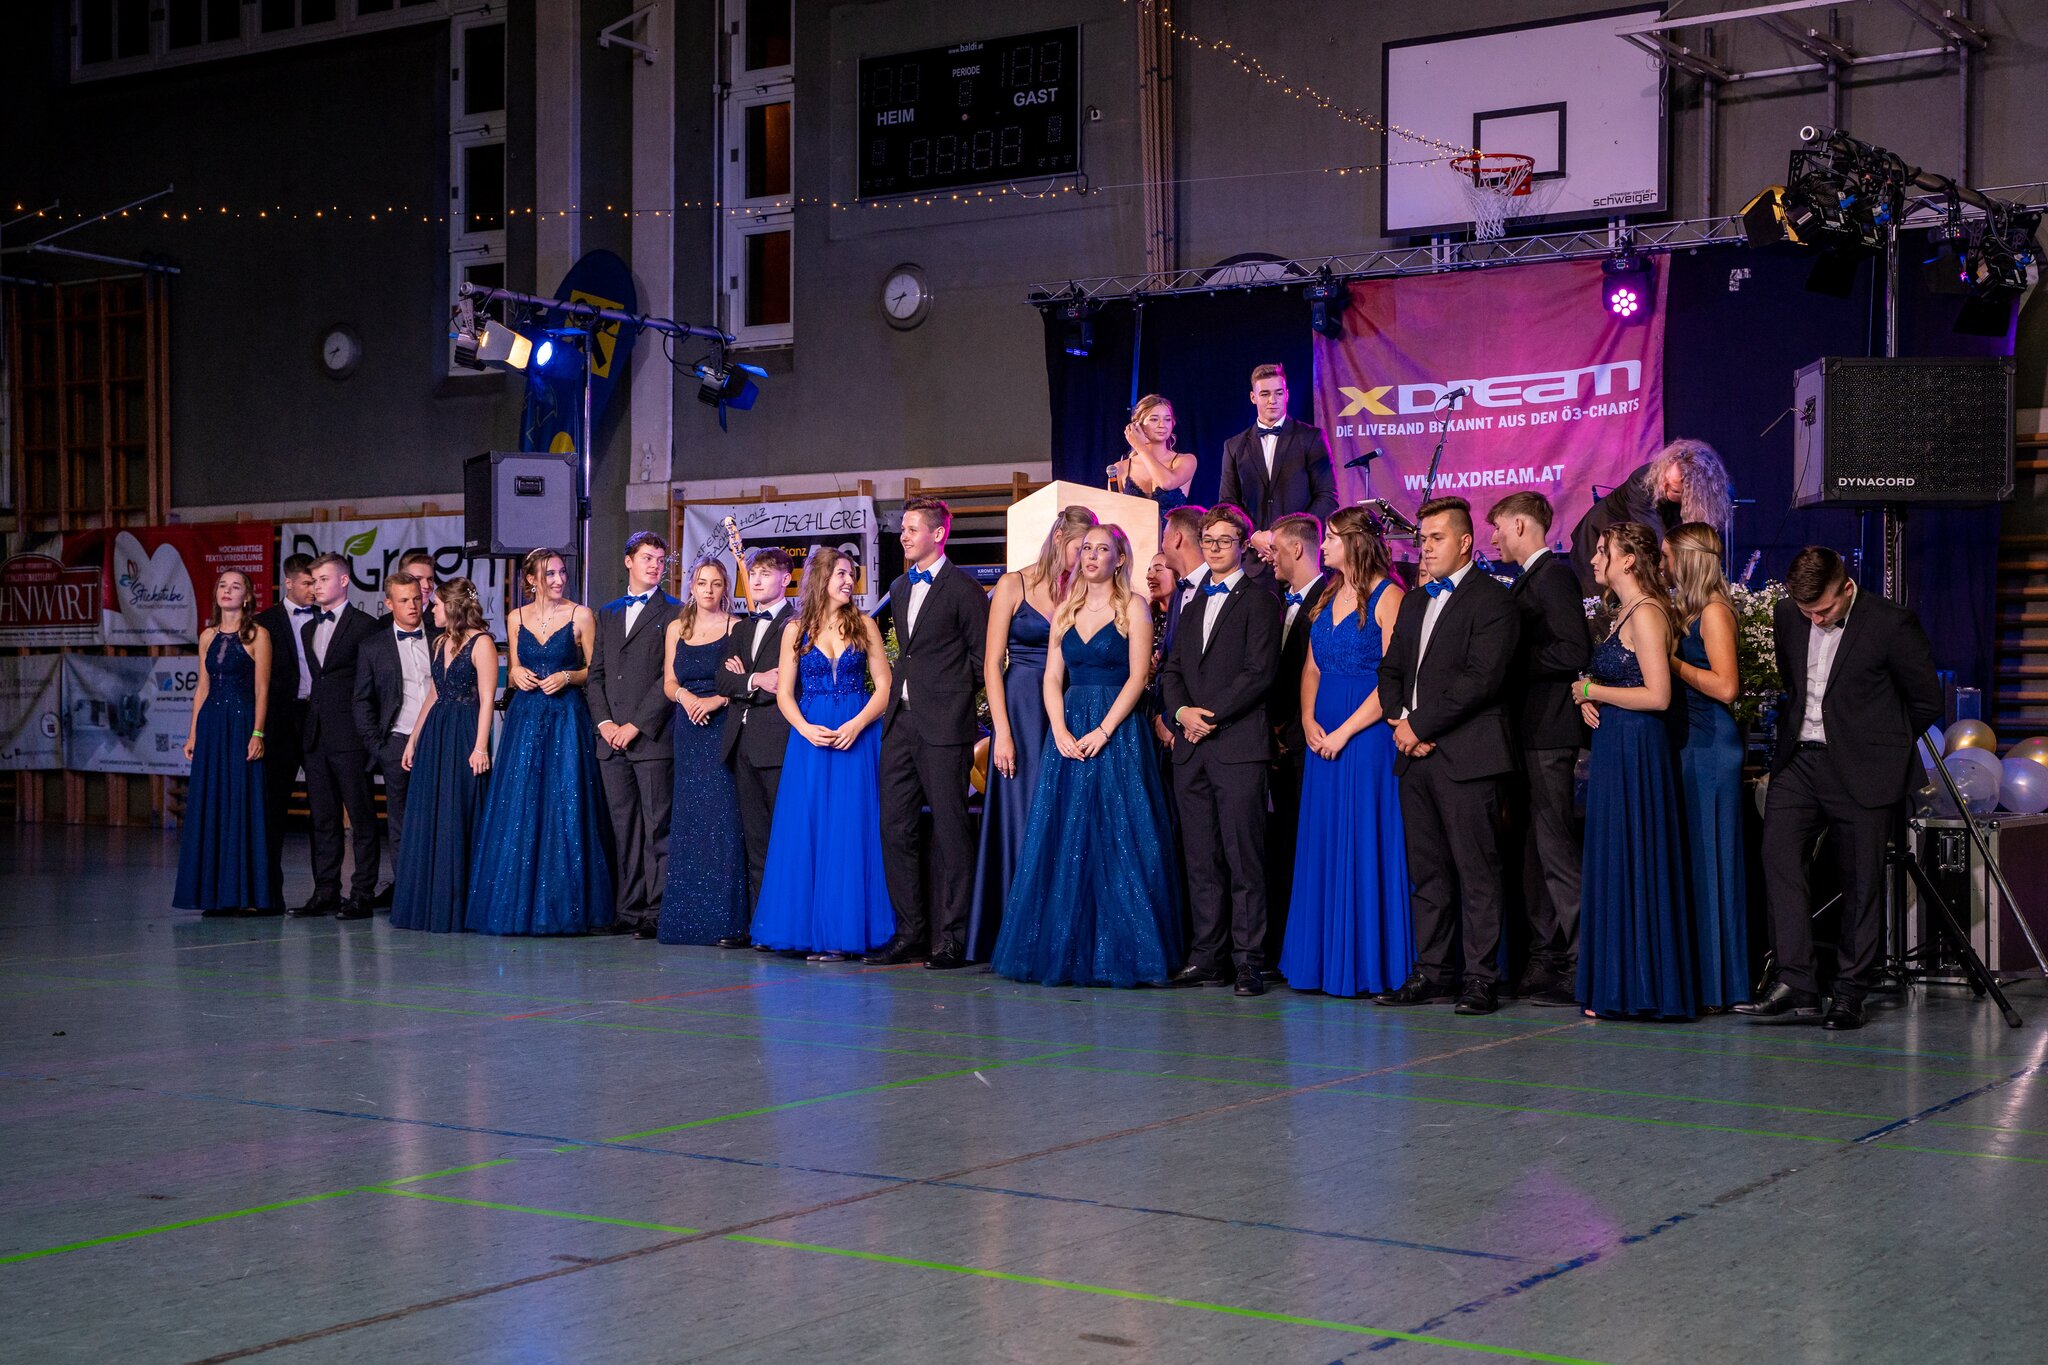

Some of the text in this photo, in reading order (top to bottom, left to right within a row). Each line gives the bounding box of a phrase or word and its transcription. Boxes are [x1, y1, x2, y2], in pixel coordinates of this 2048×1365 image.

[952, 65, 981, 77] PERIODE
[1013, 87, 1059, 107] GAST
[877, 108, 915, 127] HEIM
[1593, 192, 1657, 207] schweiger
[1336, 397, 1640, 438] DIE LIVEBAND BEKANNT AUS DEN Ö3-CHARTS
[1403, 464, 1565, 491] WWW.XDREAM.AT
[1838, 477, 1916, 487] DYNACORD
[739, 507, 767, 527] HOLZ
[771, 508, 867, 534] TISCHLEREI
[218, 544, 263, 554] HOCHWERTIGE
[688, 512, 737, 574] RFEKTION
[782, 546, 807, 557] Franz
[129, 580, 185, 606] Stickstube
